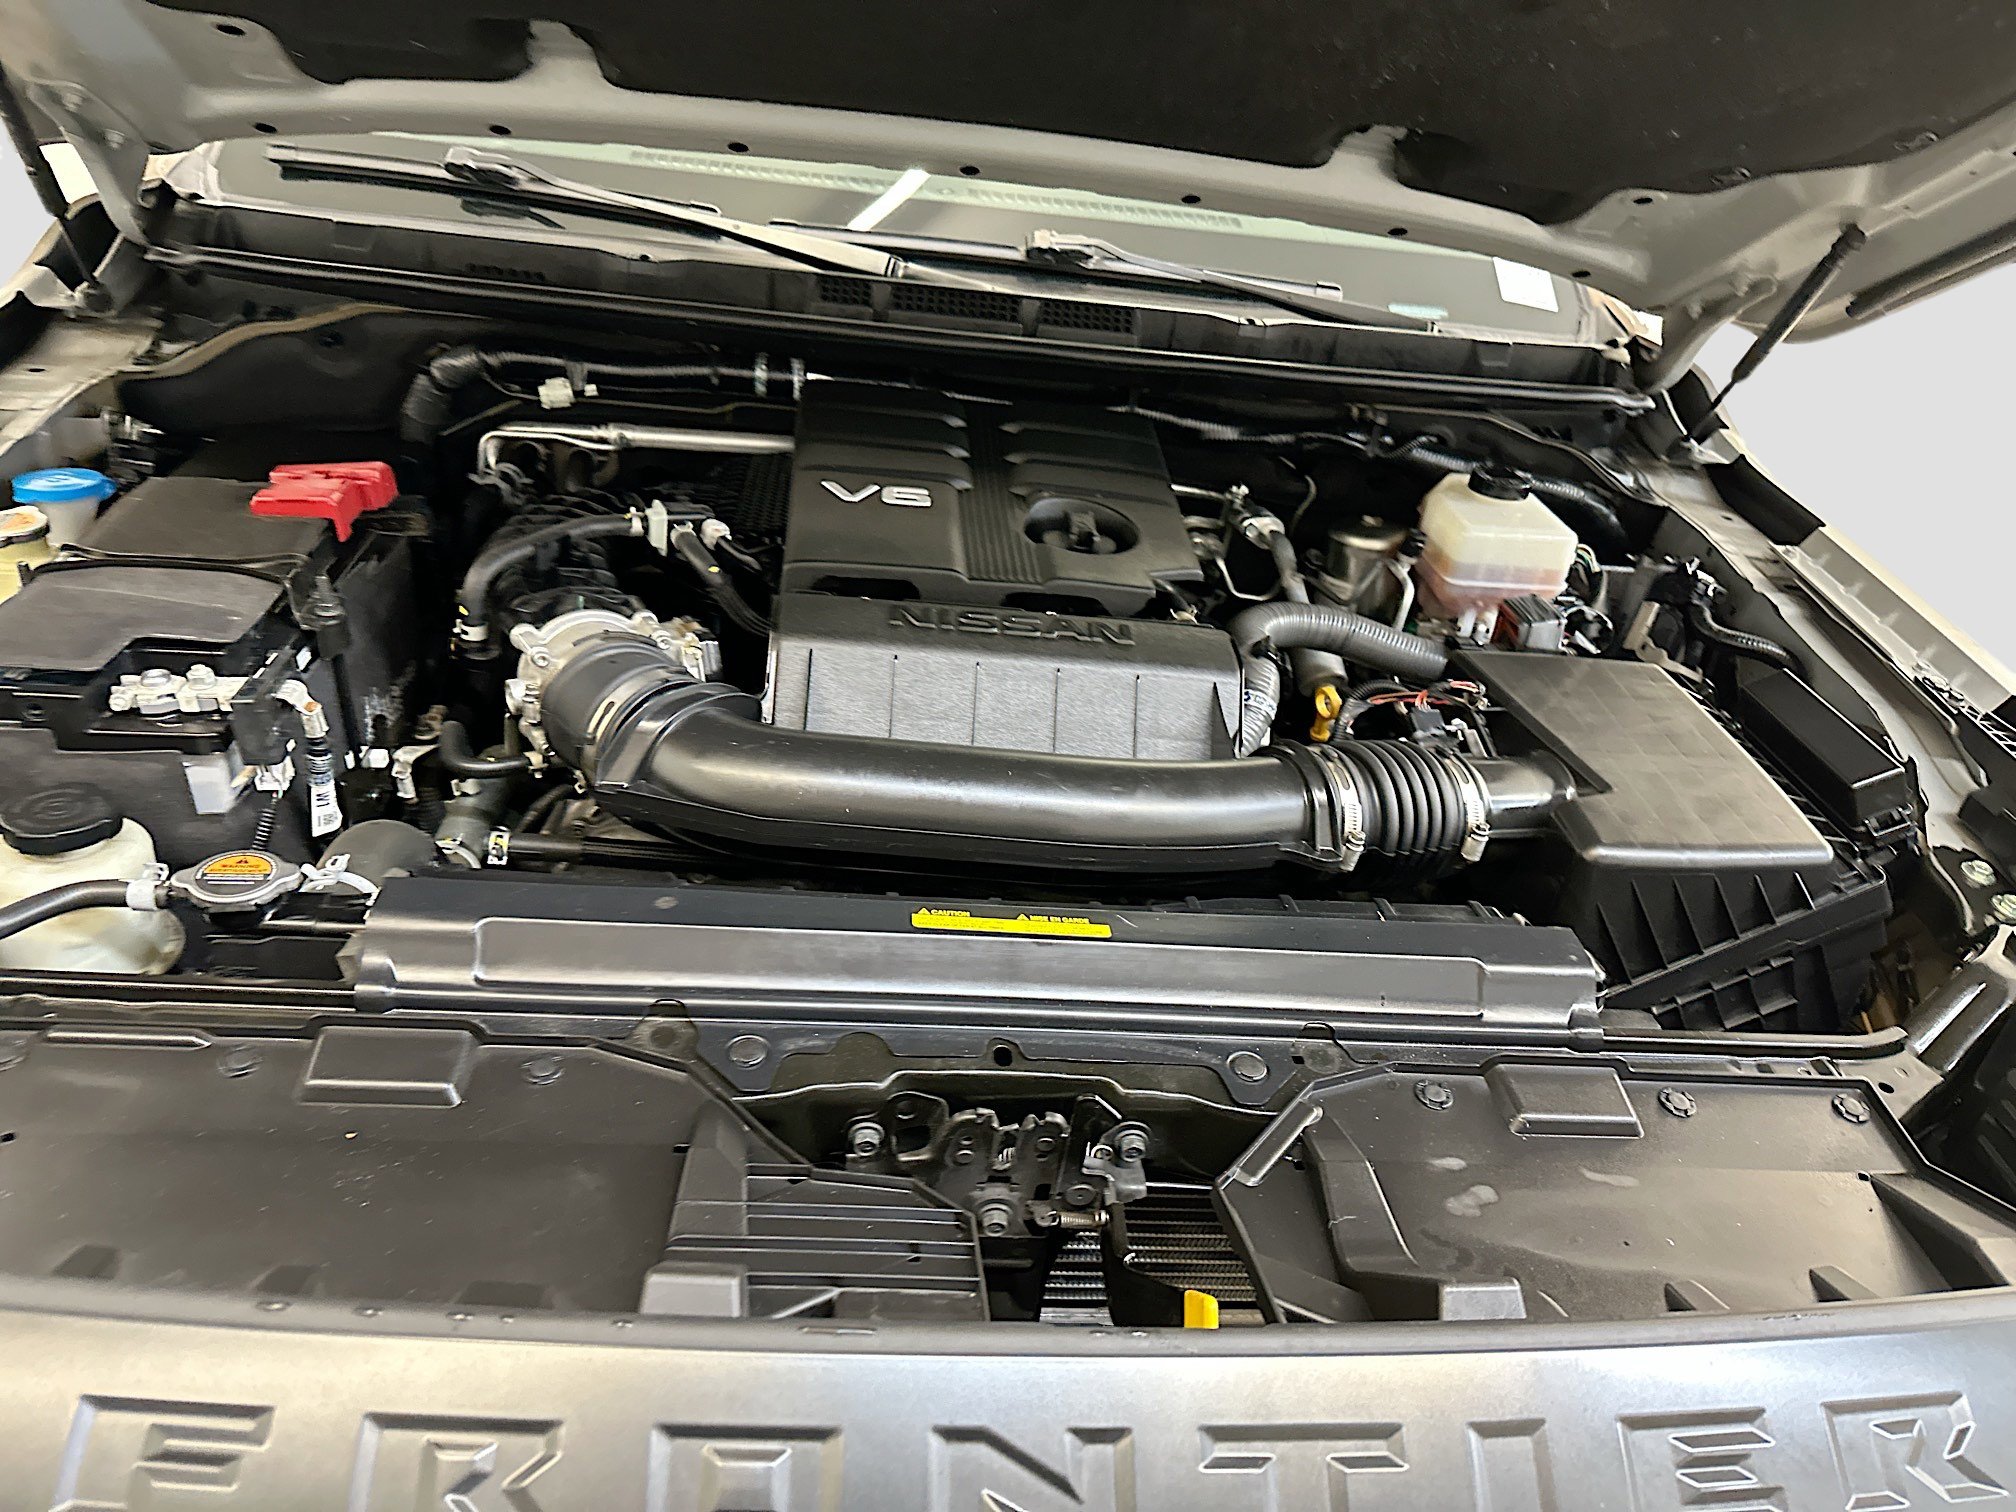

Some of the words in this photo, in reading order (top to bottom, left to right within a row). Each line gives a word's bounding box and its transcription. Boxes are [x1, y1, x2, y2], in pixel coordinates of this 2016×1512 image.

[820, 480, 932, 507] V6
[889, 604, 1135, 646] NISSAN
[931, 909, 970, 917] CAUTION
[48, 1391, 2009, 1512] FRONTIER
